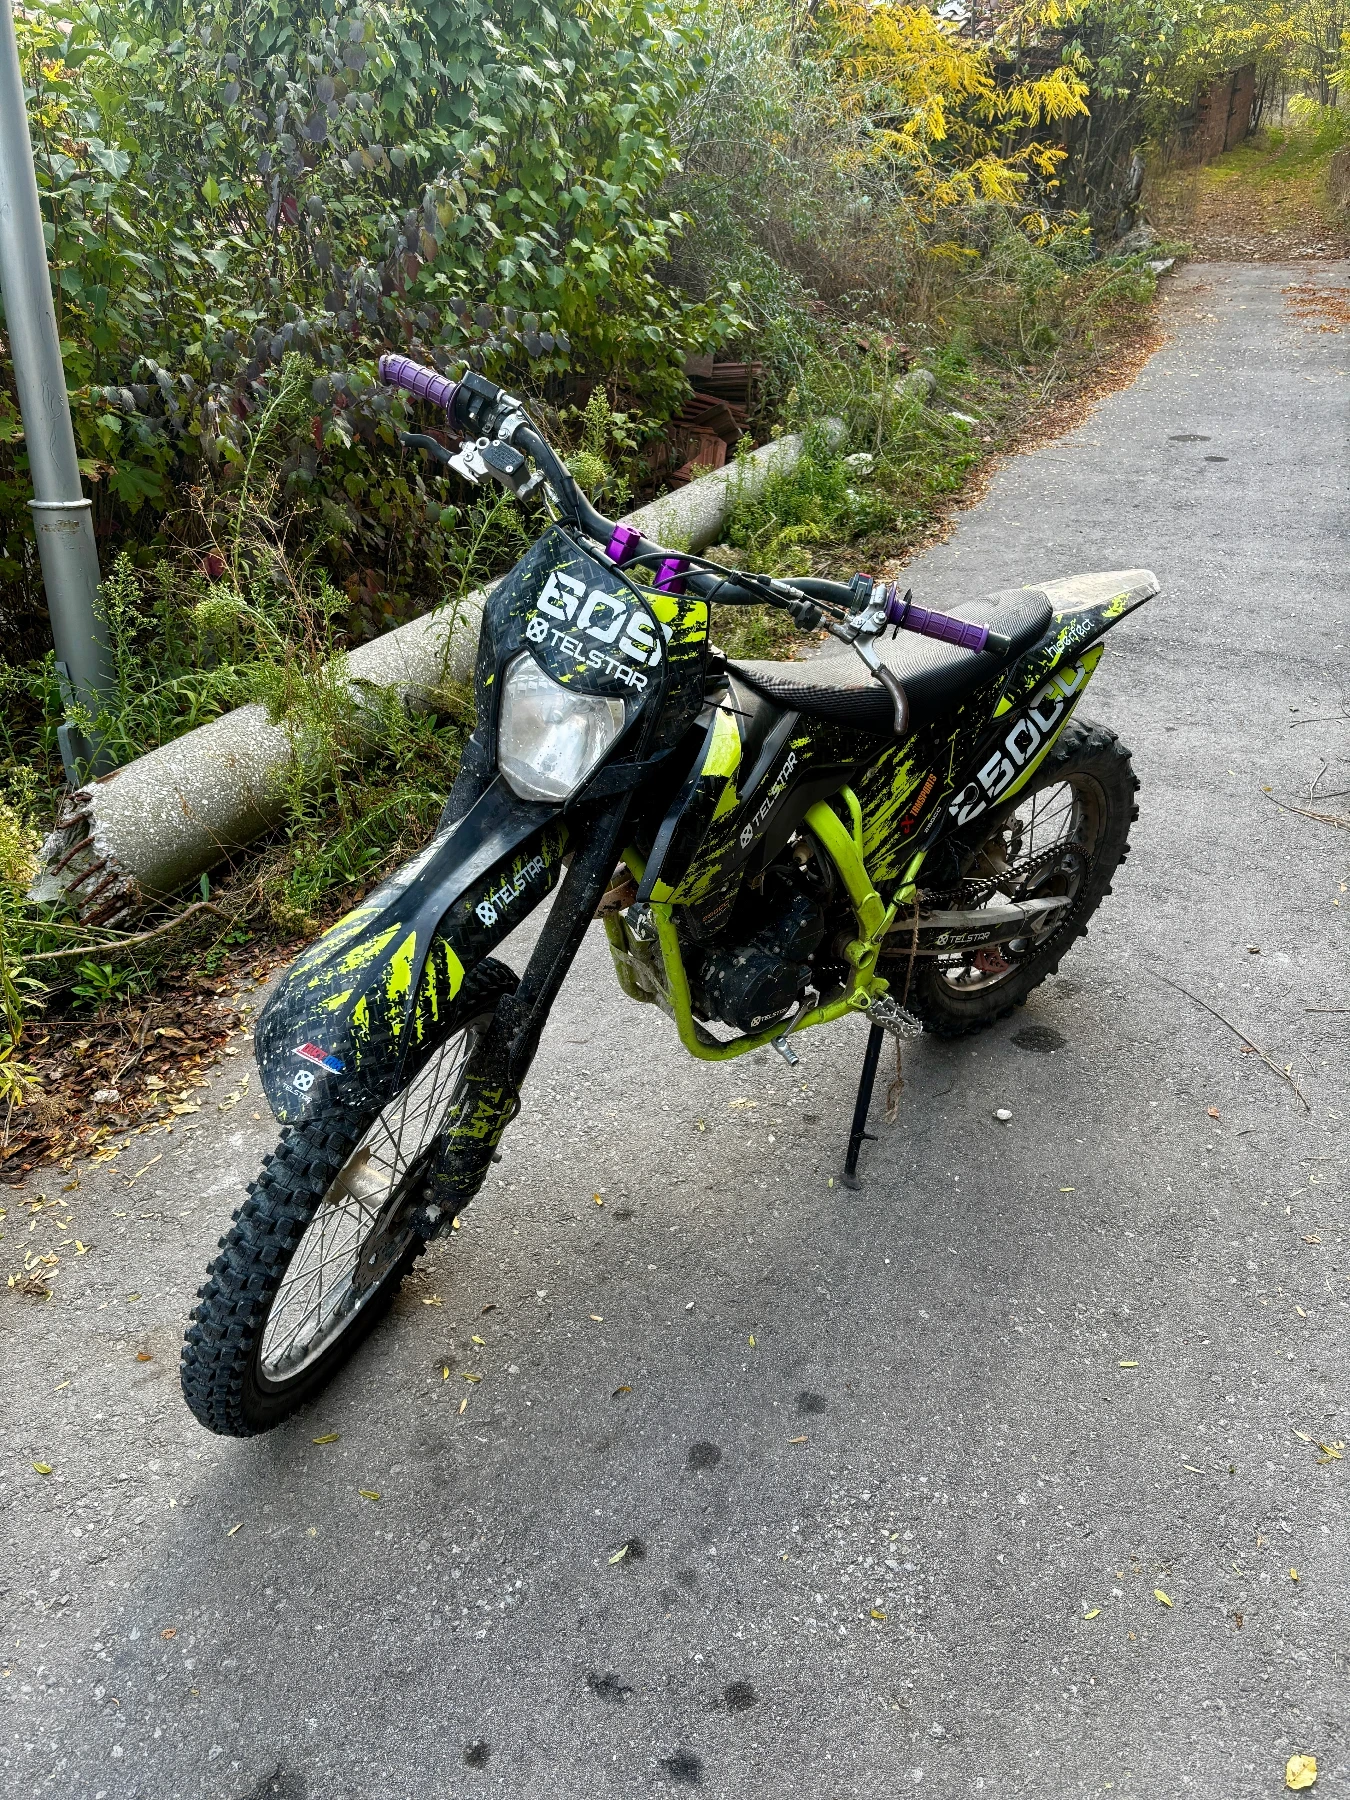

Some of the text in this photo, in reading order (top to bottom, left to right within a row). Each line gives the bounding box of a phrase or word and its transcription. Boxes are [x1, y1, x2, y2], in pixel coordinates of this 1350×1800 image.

[550, 628, 649, 693] TELSTAR
[752, 751, 799, 827] TELSTAR
[490, 855, 549, 910] TELSTAR
[949, 931, 992, 943] TELSTAR
